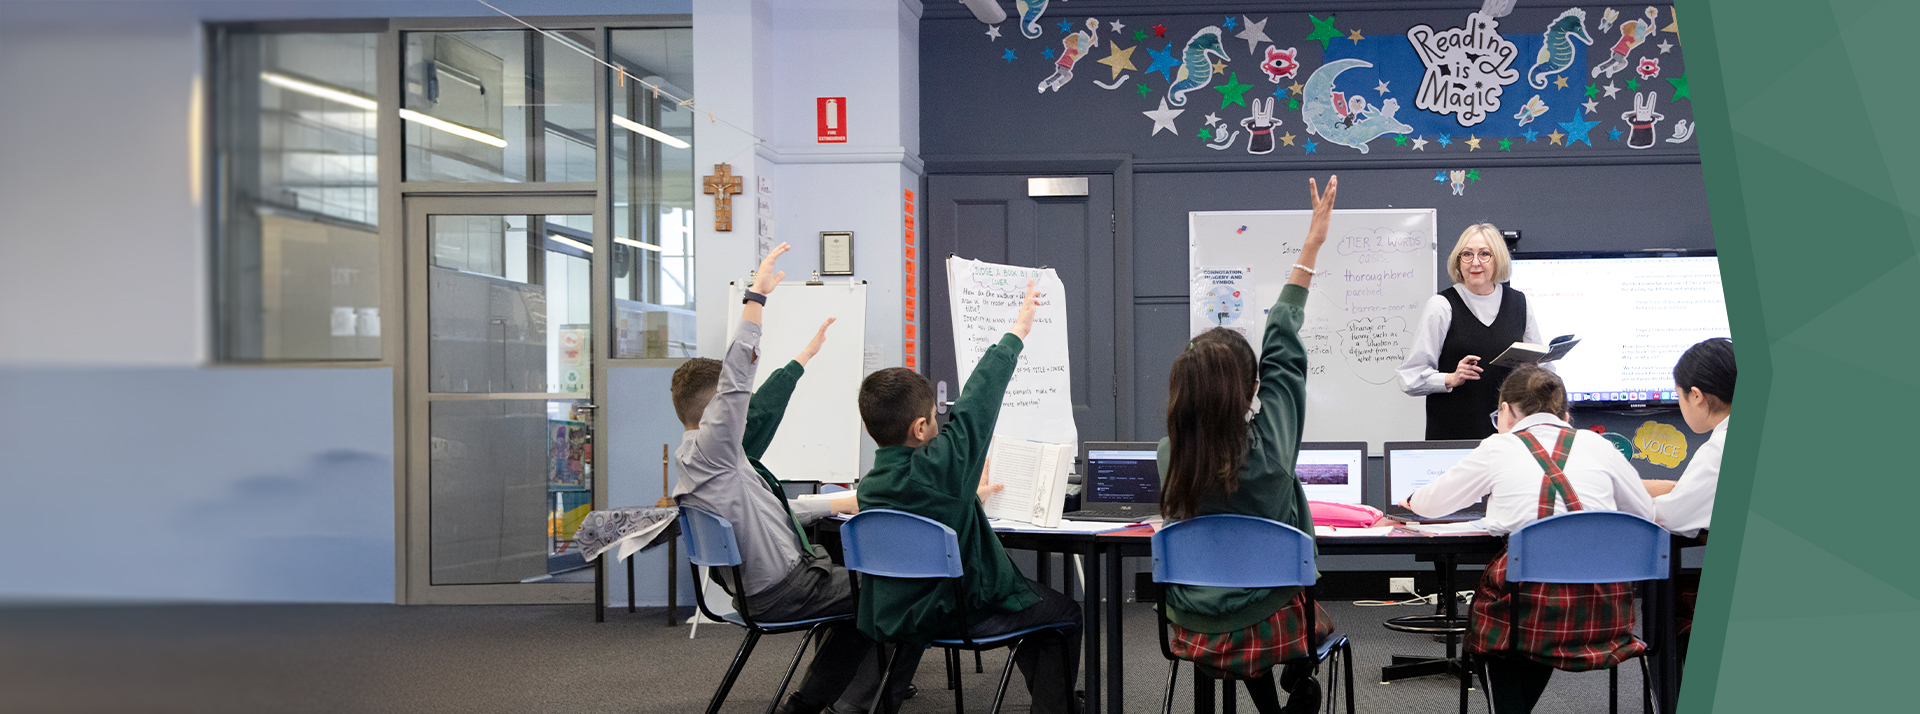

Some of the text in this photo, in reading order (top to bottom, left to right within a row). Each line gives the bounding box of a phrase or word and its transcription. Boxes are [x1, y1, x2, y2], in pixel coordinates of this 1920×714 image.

[1414, 18, 1515, 79] Reading
[1455, 61, 1470, 79] is
[1421, 69, 1497, 120] Magic
[1345, 235, 1421, 249] TIER 2 WORDS
[974, 266, 994, 277] JUDGE
[996, 268, 1001, 277] A
[1003, 269, 1018, 277] BOOK
[1020, 270, 1028, 278] BY
[1343, 268, 1414, 287] thoroughbred
[962, 287, 975, 295] How
[1345, 287, 1382, 305] parched
[1642, 438, 1681, 459] VOICE
